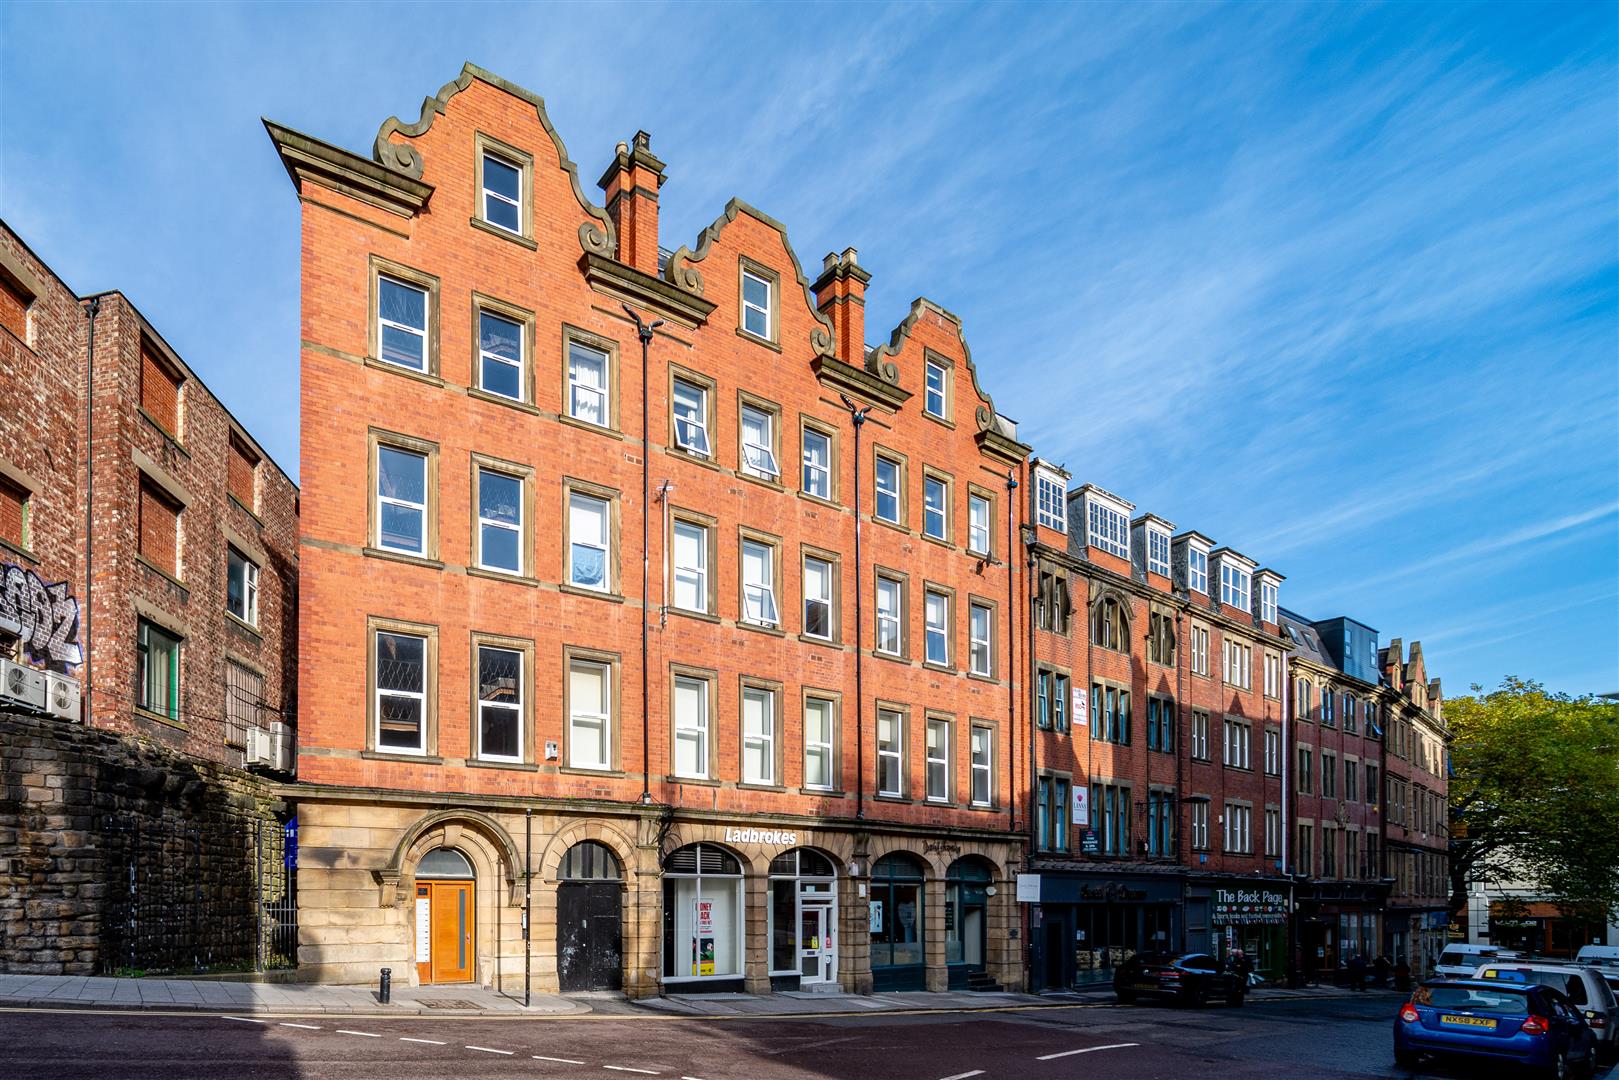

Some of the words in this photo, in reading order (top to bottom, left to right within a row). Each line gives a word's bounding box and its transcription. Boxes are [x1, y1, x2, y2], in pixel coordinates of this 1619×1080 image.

[725, 826, 797, 845] Ladbrokes
[1216, 889, 1235, 903] The
[1237, 889, 1260, 903] Back
[1262, 890, 1283, 905] Page
[1445, 1016, 1470, 1024] NX58
